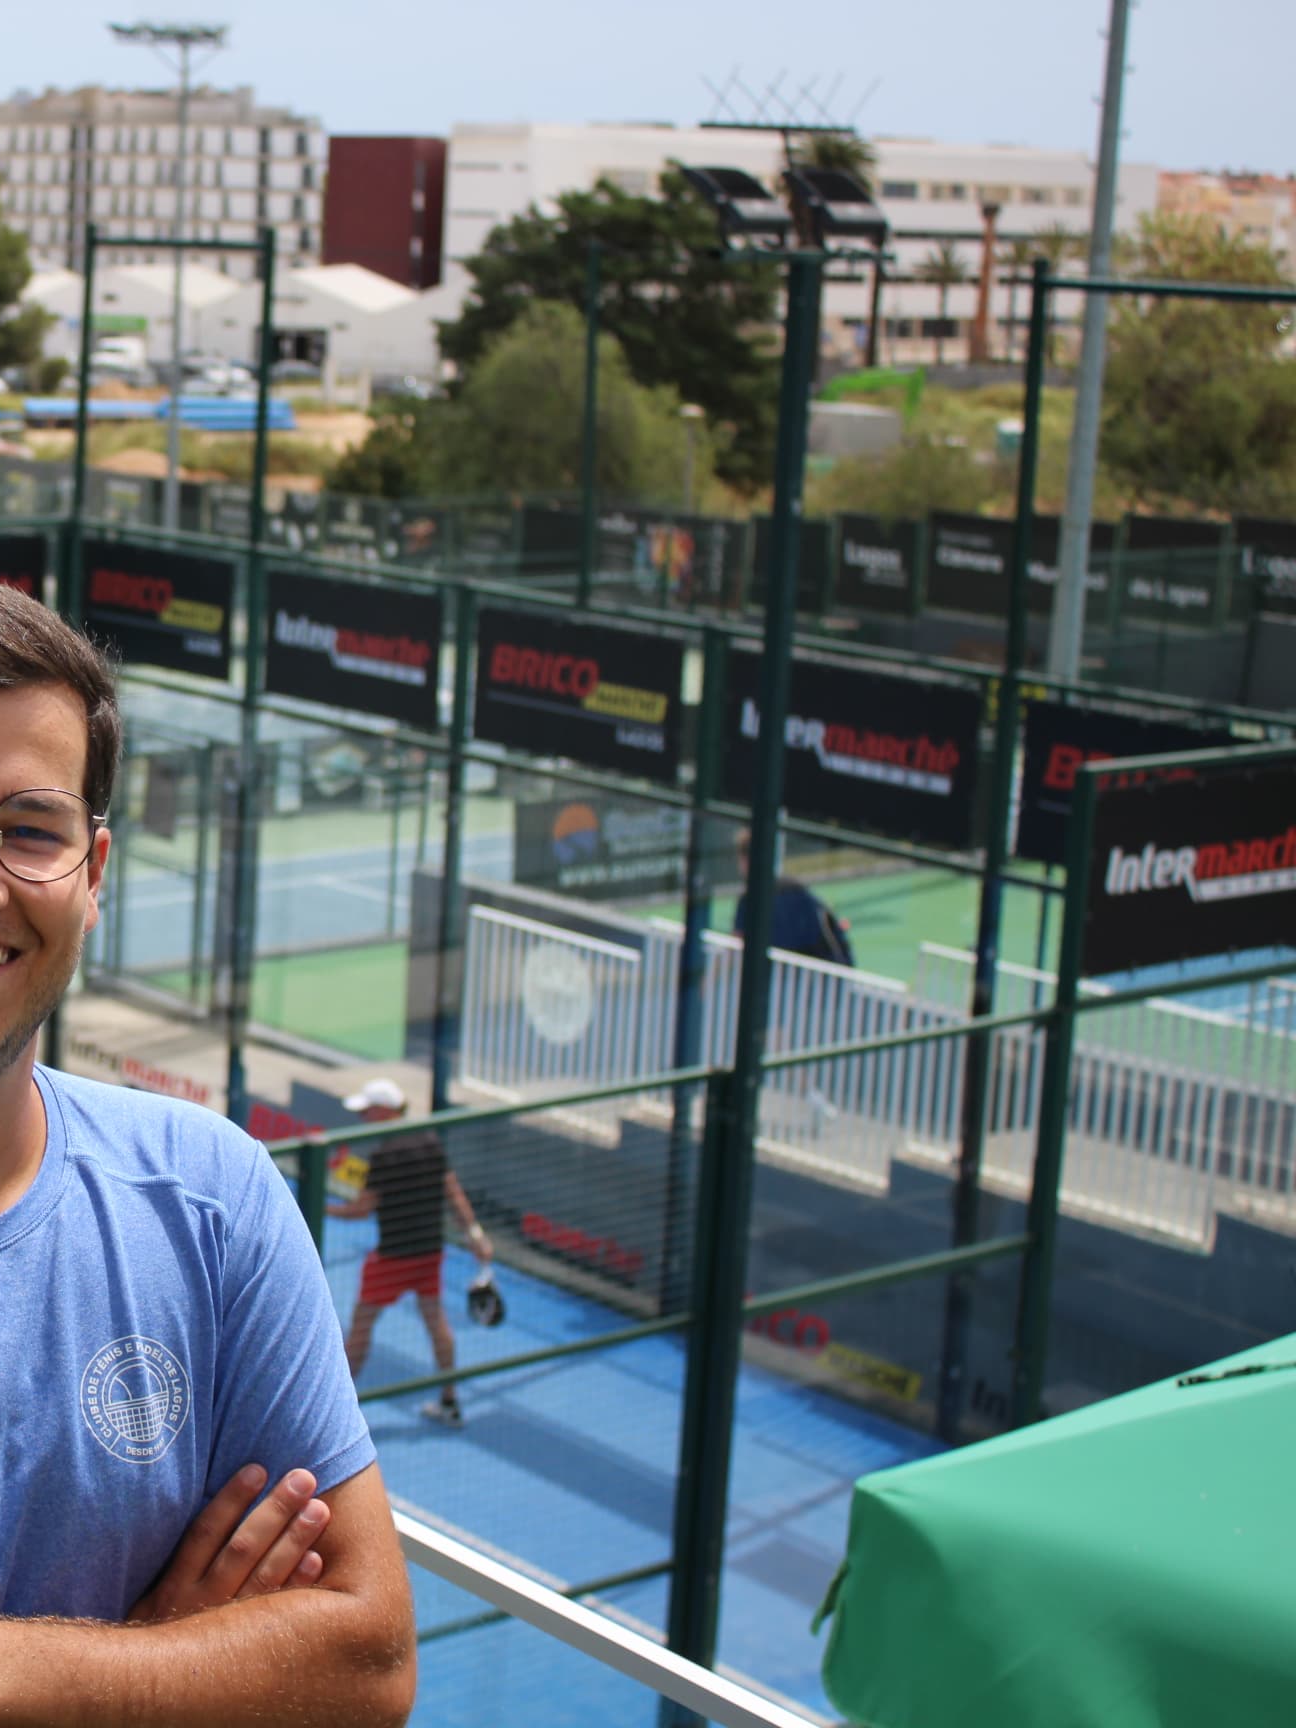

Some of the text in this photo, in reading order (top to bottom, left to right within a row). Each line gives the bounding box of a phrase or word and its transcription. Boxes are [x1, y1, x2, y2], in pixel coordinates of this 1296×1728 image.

[490, 643, 600, 699] BRICO
[125, 1343, 133, 1353] E
[163, 1359, 178, 1377] DE
[87, 1376, 99, 1395] DE
[169, 1378, 183, 1422] LAGOS
[88, 1397, 112, 1438] CLUBE
[126, 1445, 154, 1456] DESDE
